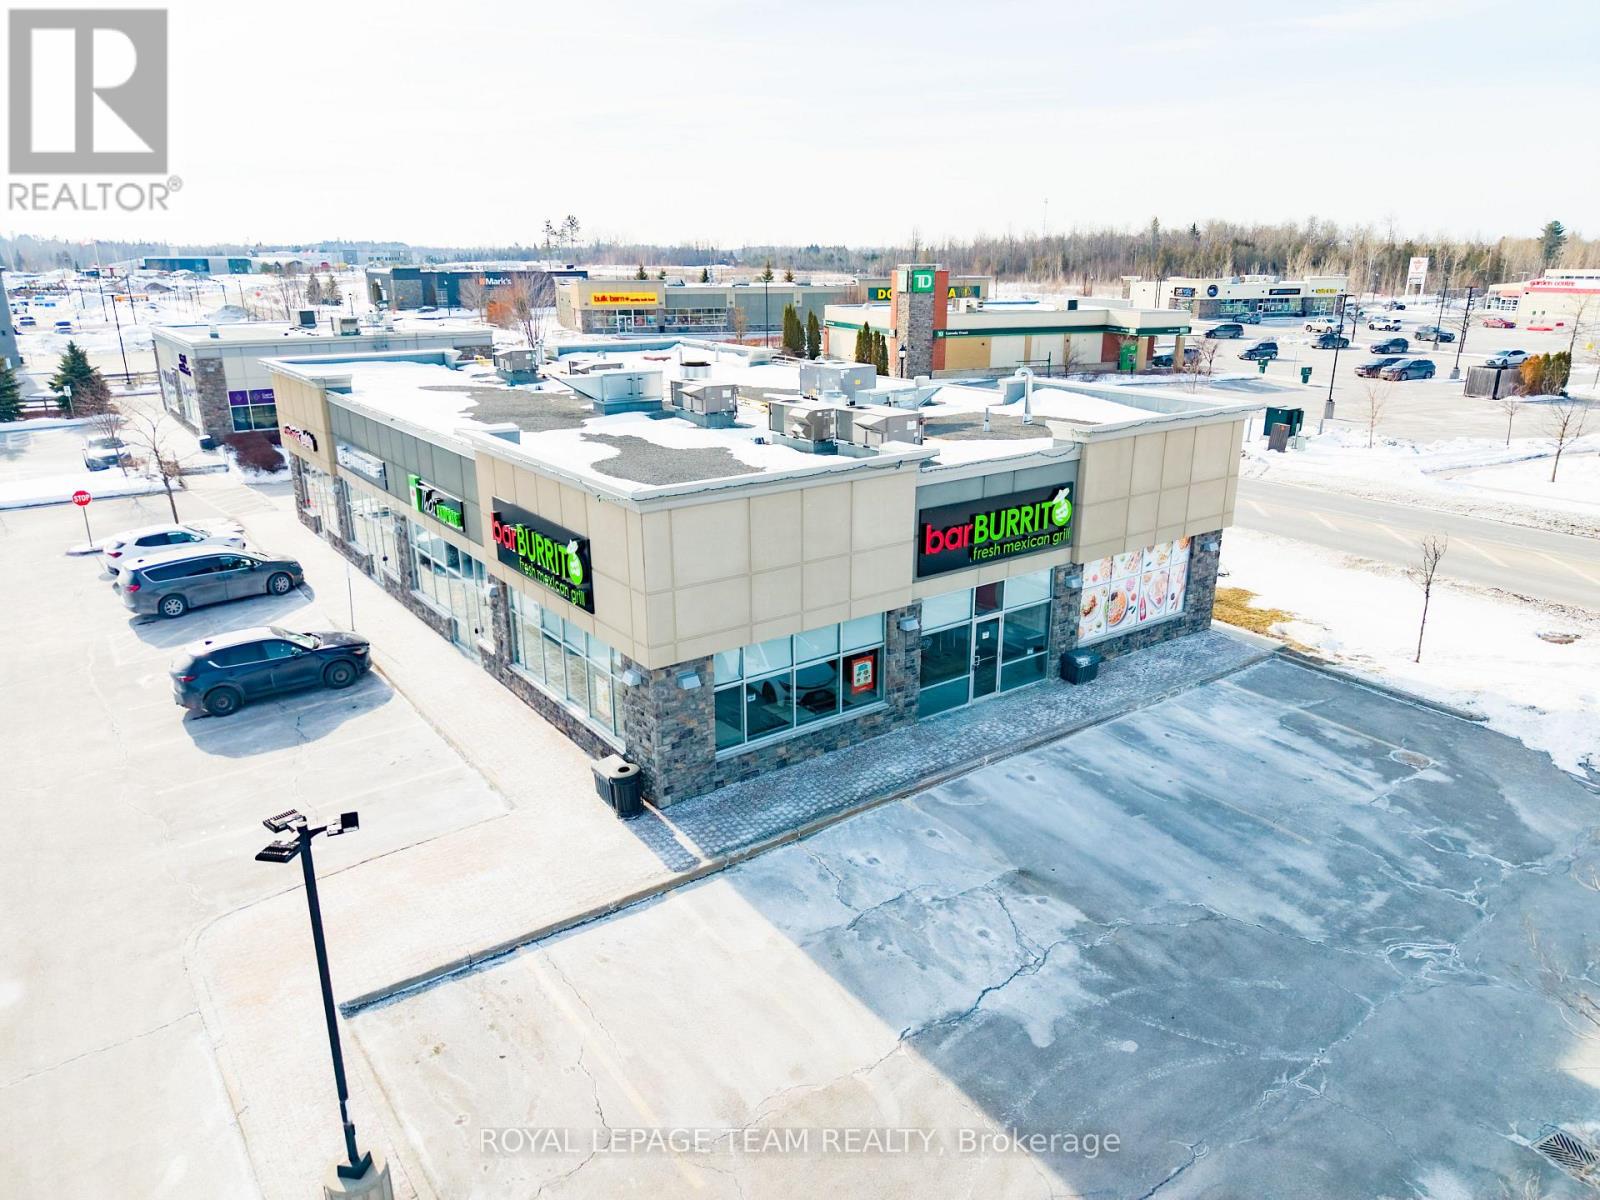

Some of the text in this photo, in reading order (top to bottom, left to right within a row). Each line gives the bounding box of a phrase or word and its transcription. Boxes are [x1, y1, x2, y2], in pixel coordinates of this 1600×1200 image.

[485, 277, 512, 286] Mark's
[915, 274, 932, 289] TD
[73, 494, 90, 503] STOP
[973, 528, 1071, 561] fresh mexican grill
[519, 556, 586, 606] fresh mexican grill
